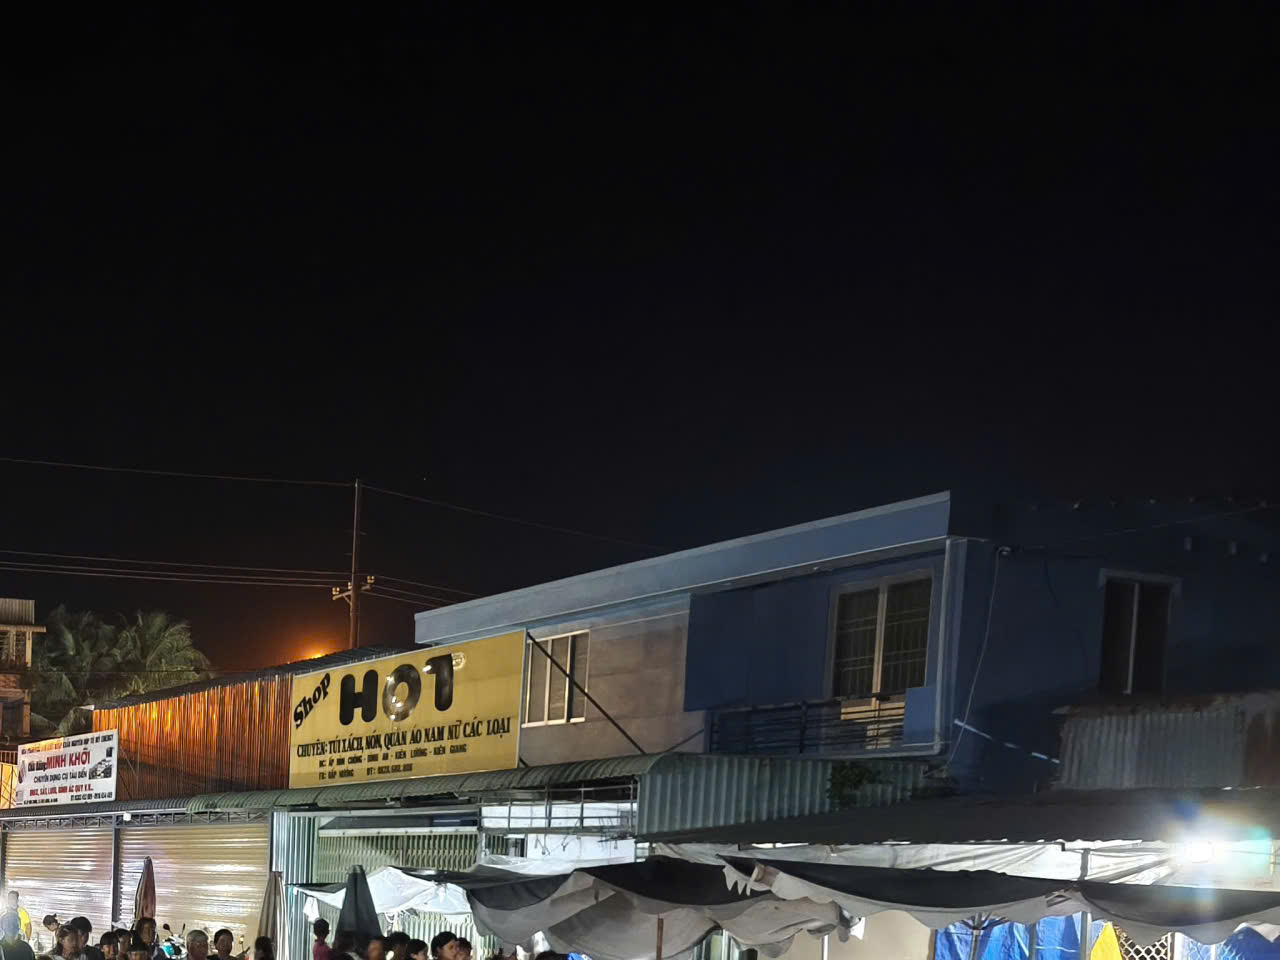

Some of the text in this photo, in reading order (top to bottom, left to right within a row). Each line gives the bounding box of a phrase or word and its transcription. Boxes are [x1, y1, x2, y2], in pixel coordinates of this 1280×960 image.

[293, 672, 331, 729] Shop
[328, 735, 341, 754] TÚI
[409, 724, 422, 745] ÁO
[423, 725, 445, 743] NAM
[463, 716, 483, 738] CÁC
[487, 717, 511, 739] LOẠI
[47, 753, 66, 769] MINH
